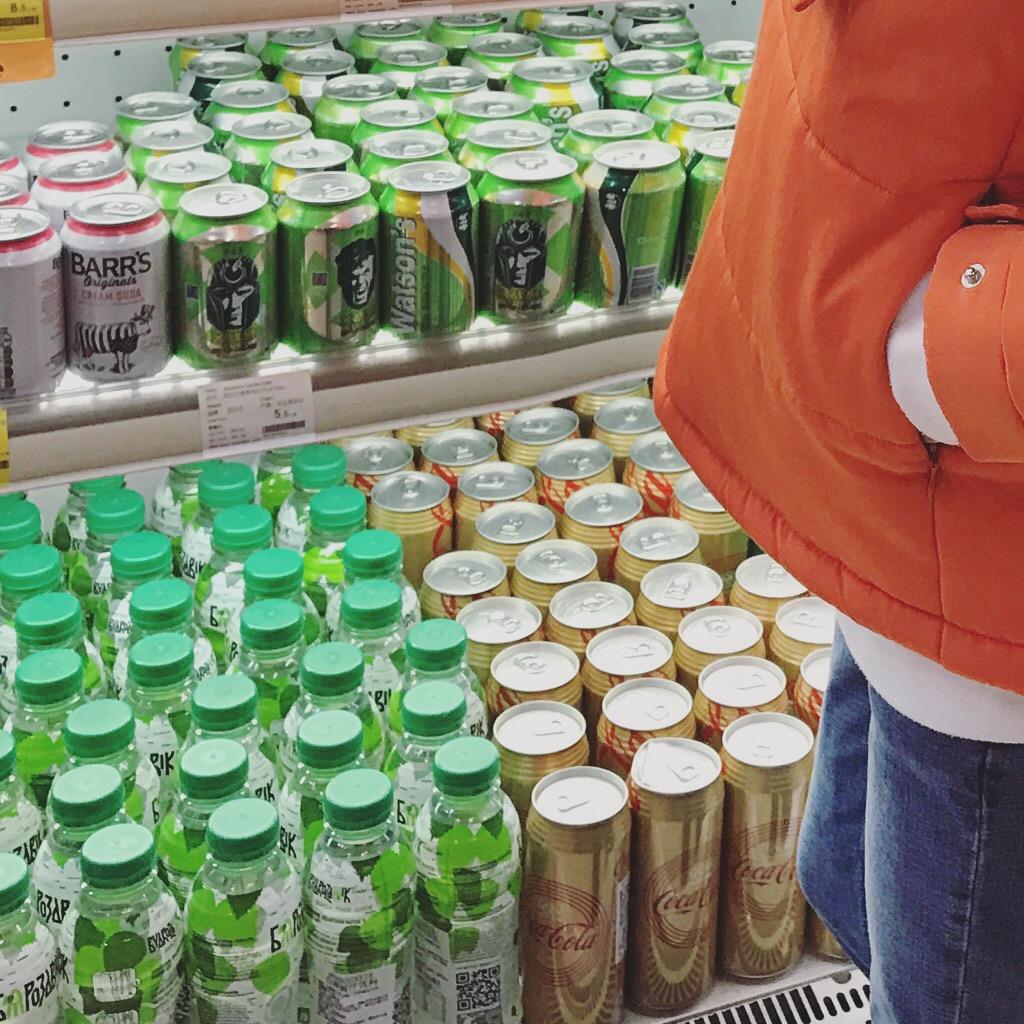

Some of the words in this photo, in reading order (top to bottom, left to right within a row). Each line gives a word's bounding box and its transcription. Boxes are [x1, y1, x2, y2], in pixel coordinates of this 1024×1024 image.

[70, 249, 152, 278] BARR'S
[391, 217, 417, 334] Watson's
[83, 275, 138, 290] Originals
